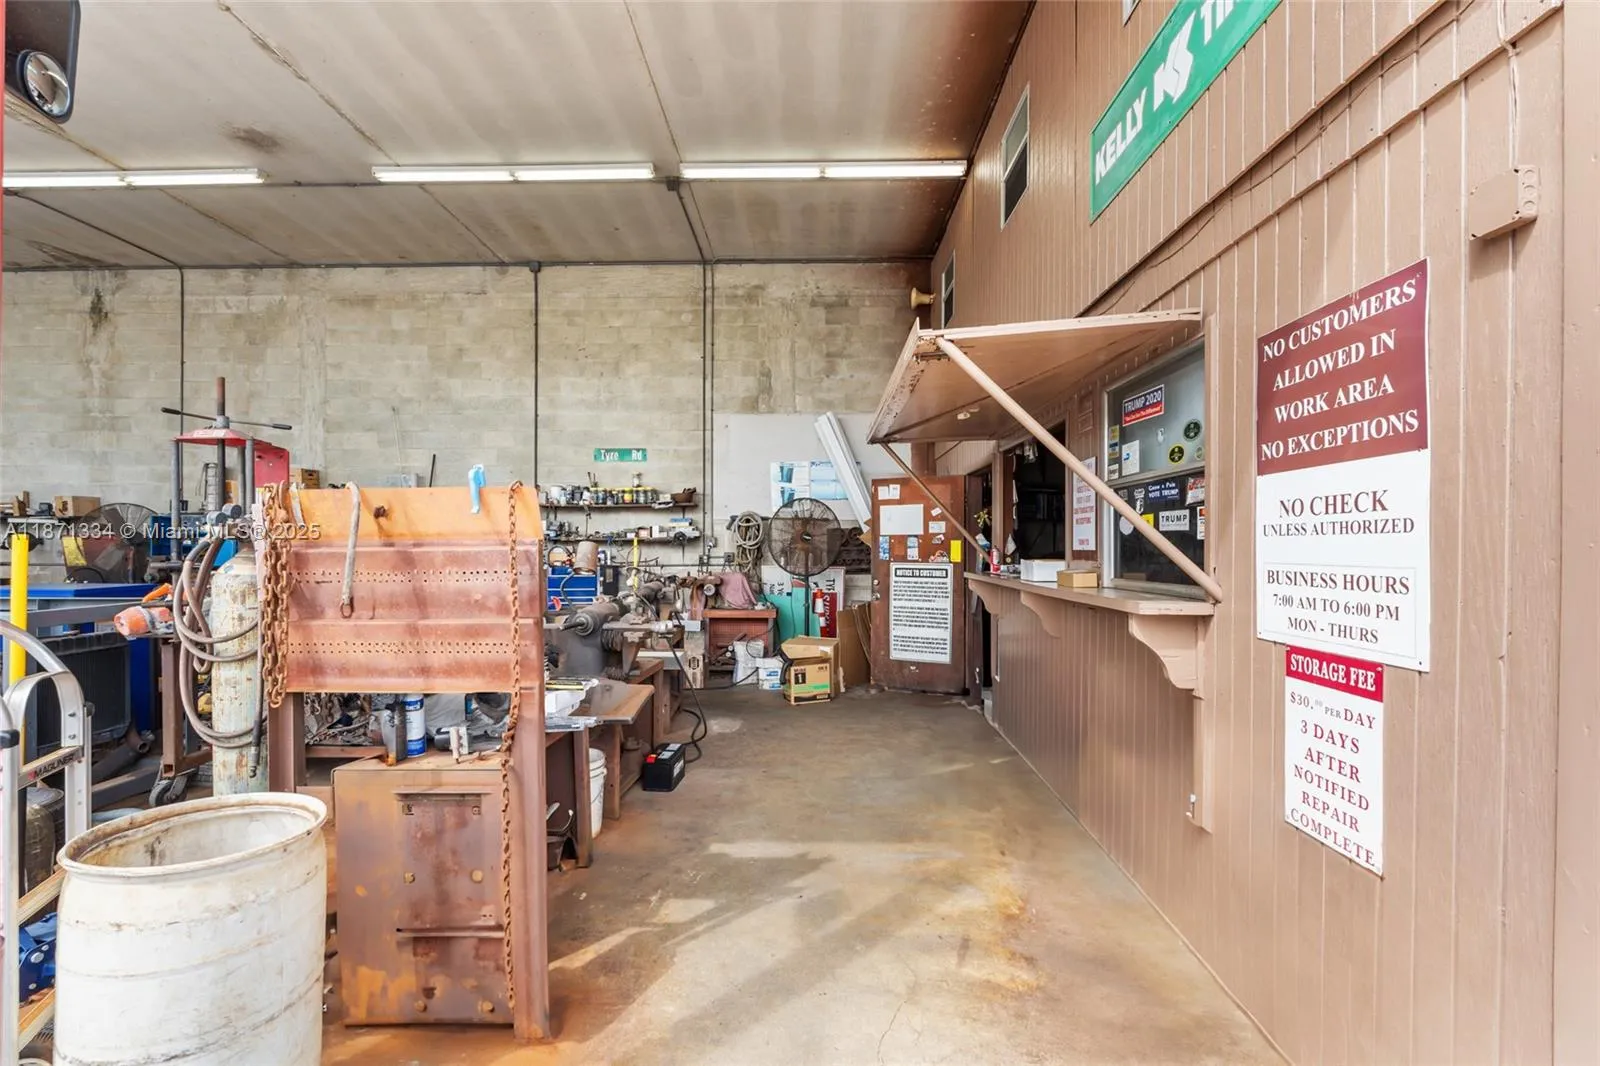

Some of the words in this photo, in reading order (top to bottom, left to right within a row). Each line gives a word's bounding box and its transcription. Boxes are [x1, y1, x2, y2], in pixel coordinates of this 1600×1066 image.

[1095, 87, 1147, 186] KELLY
[1200, 0, 1234, 45] TI
[1263, 337, 1285, 362] NO
[1288, 278, 1418, 348] CUSTOMERS
[1273, 341, 1366, 391] ALLOWED
[1369, 328, 1397, 360] IN
[1125, 397, 1146, 413] TRUMP
[1146, 391, 1162, 405] 2020
[1274, 391, 1330, 424] WORK
[1334, 373, 1395, 410] AREA
[1261, 440, 1285, 461] NO
[1287, 409, 1421, 457] EXCEPTIONS
[600, 449, 619, 462] Tyre
[631, 449, 643, 461] Rd
[1149, 490, 1160, 498] VOTE
[1161, 488, 1179, 496] TRUMP
[1279, 498, 1305, 519] NO
[1309, 489, 1389, 516] CHECK
[1161, 513, 1187, 523] TRUMP
[1263, 521, 1308, 538] UNLESS
[1310, 517, 1415, 537] AUTHORIZED
[896, 569, 913, 577] NOTICE
[1266, 569, 1338, 590] BUSINESS
[1342, 574, 1410, 596] HOURS
[1273, 593, 1294, 609] 7:00
[1296, 597, 1317, 612] AM
[1320, 600, 1341, 615] TO
[1343, 600, 1372, 619] 6:00
[1375, 604, 1400, 621] PM
[1287, 616, 1317, 633] MON
[1327, 623, 1379, 645] THURS
[1290, 653, 1347, 685] STORAGE
[1349, 669, 1376, 692] FEE
[1324, 706, 1342, 719] PER
[1343, 708, 1376, 730] DAY
[1300, 720, 1308, 734] 3
[1313, 723, 1360, 754] DAYS
[1304, 747, 1361, 783] AFTER
[1294, 764, 1370, 811] NOTIFIED
[1302, 791, 1360, 833] REPAIR
[1291, 808, 1376, 867] COMPLETE
